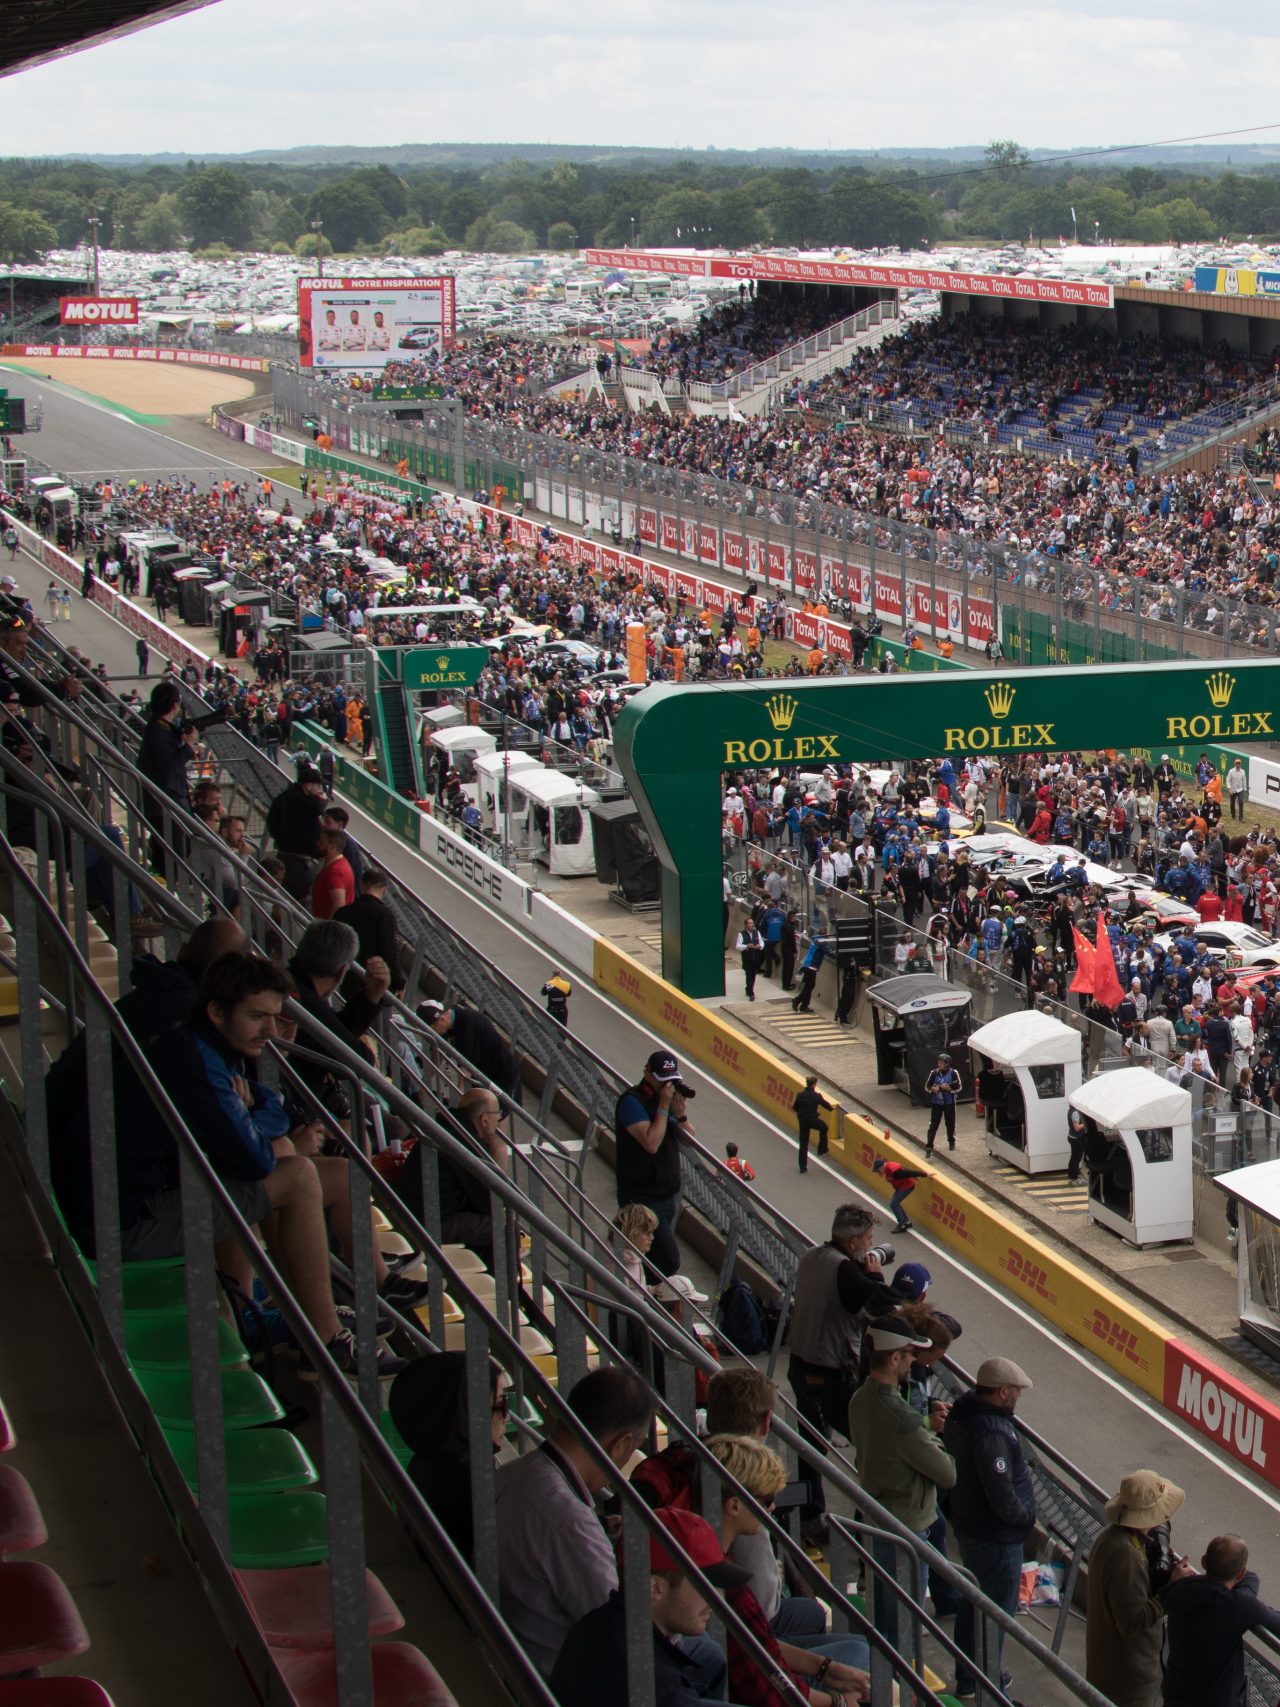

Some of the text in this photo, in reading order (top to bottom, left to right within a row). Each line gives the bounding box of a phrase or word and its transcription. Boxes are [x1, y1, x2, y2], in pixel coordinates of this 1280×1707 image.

[692, 262, 704, 273] TOTAL
[301, 279, 343, 288] MOTUL
[352, 279, 441, 288] NOTRE INSPIRATION
[752, 258, 1108, 303] TOTAL TOTAL TOTAL TOTAL TOTAL TOTAL TOTAL TOTAL TOTAL TOTAL TOTAL TOTAL TOTAL TOTAL TOTAL TOTAL TOTAL TOTAL
[65, 303, 134, 319] MOTUL
[443, 280, 451, 324] DEMARRE
[25, 346, 52, 356] MOTUL
[57, 347, 82, 357] MOTUL
[86, 347, 110, 357] MOTUL
[580, 546, 594, 562] TOTAL
[704, 588, 723, 607] TOTAL
[875, 580, 901, 605] TOTAL
[795, 619, 817, 640] TOTAL
[827, 629, 850, 653] TOTAL
[420, 671, 466, 683] ROLEX
[944, 724, 1056, 750] ROLEX
[1166, 711, 1274, 738] ROLEX
[723, 735, 840, 764] ROLEX
[1170, 758, 1192, 776] ROLEX
[437, 834, 502, 901] PORSCHE
[734, 873, 748, 884] 92
[1228, 959, 1240, 968] 92
[618, 968, 641, 997] DHL
[663, 1001, 689, 1033] DHL
[713, 1035, 740, 1072] DHL
[767, 1074, 796, 1112] DHL
[929, 1192, 969, 1240] DHL
[1006, 1247, 1048, 1301] DHL
[1091, 1308, 1139, 1364] DHL
[1178, 1363, 1267, 1469] MOTUL
